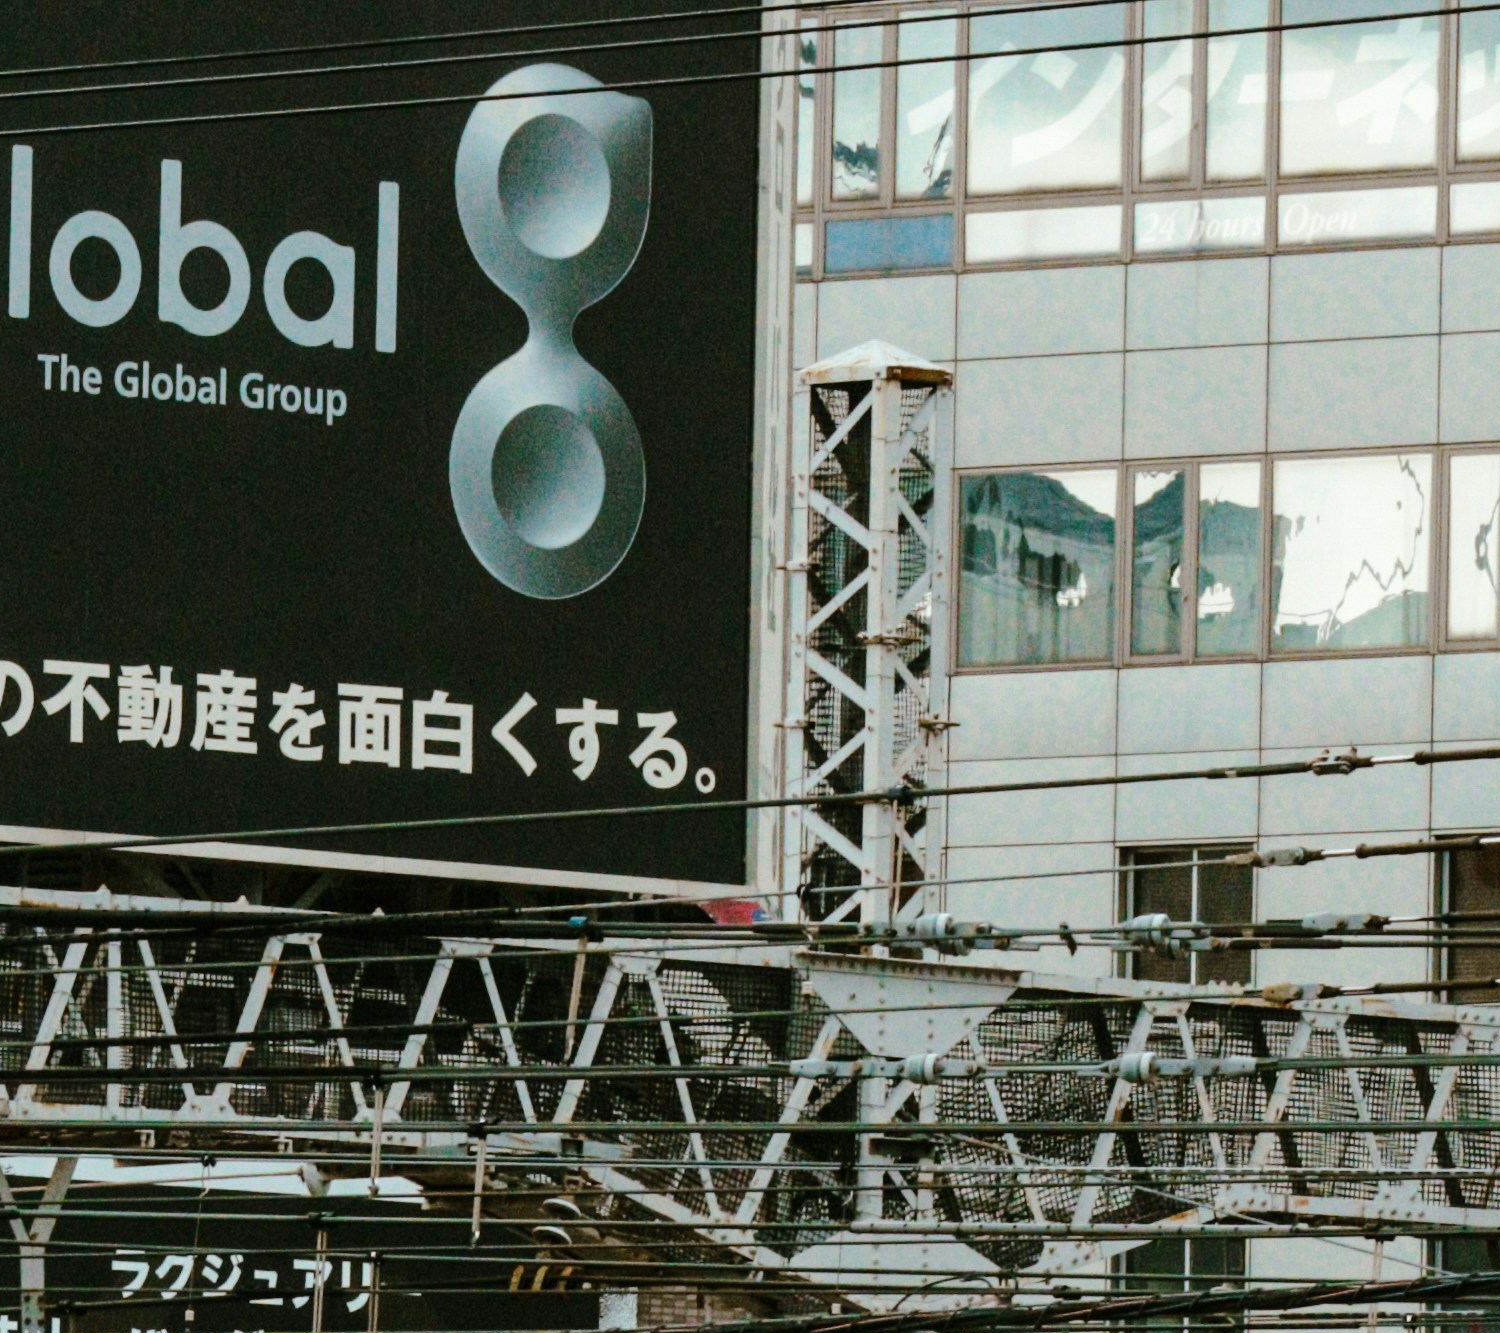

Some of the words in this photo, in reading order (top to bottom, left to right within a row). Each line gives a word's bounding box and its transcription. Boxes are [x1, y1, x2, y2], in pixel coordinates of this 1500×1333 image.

[37, 352, 103, 396] The
[114, 360, 228, 407] Global
[238, 371, 348, 426] Group
